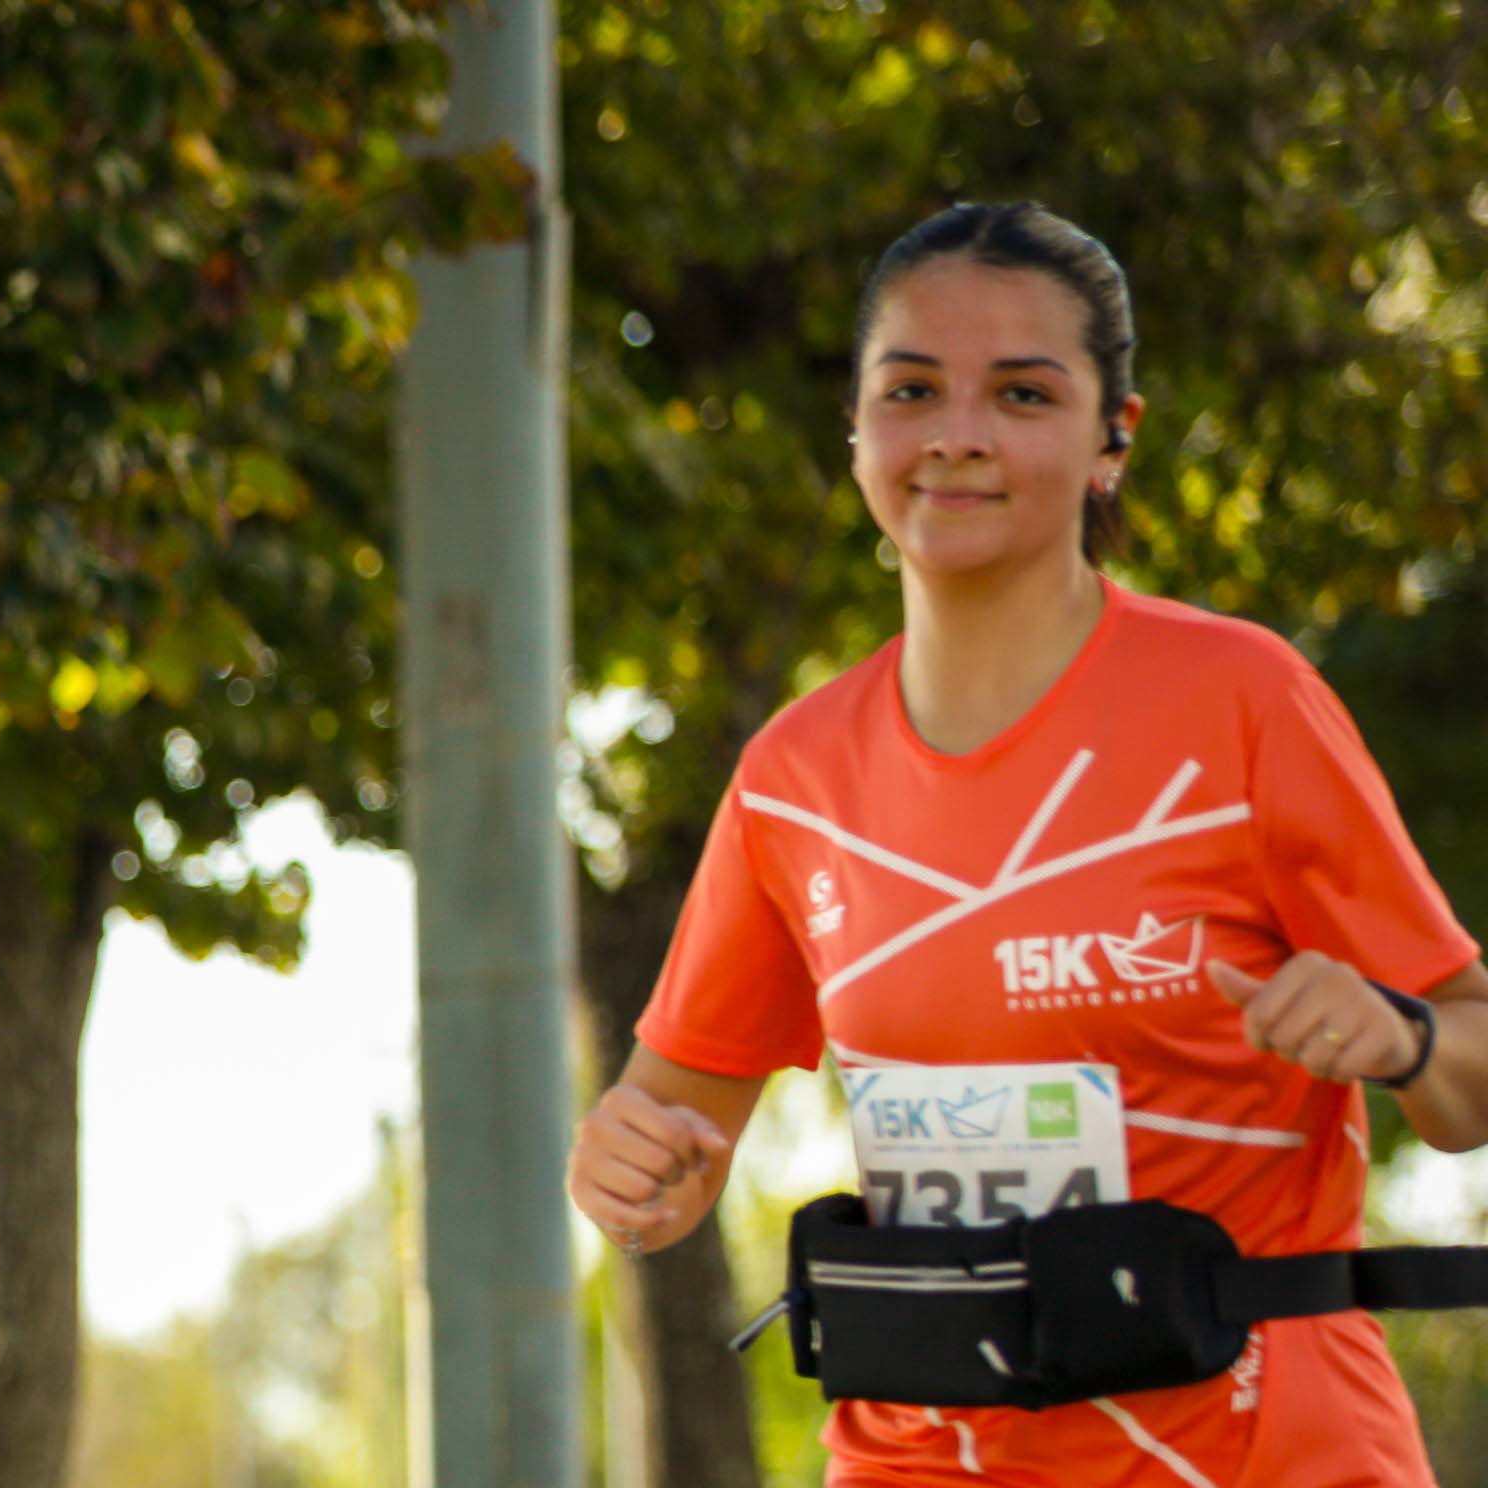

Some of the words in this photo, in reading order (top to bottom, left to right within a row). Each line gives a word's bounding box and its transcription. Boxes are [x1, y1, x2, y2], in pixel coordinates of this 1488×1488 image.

[993, 934, 1099, 992] 15K
[1006, 991, 1102, 1012] PUERTO
[1110, 979, 1201, 1005] NORTE
[868, 1098, 931, 1139] 15K
